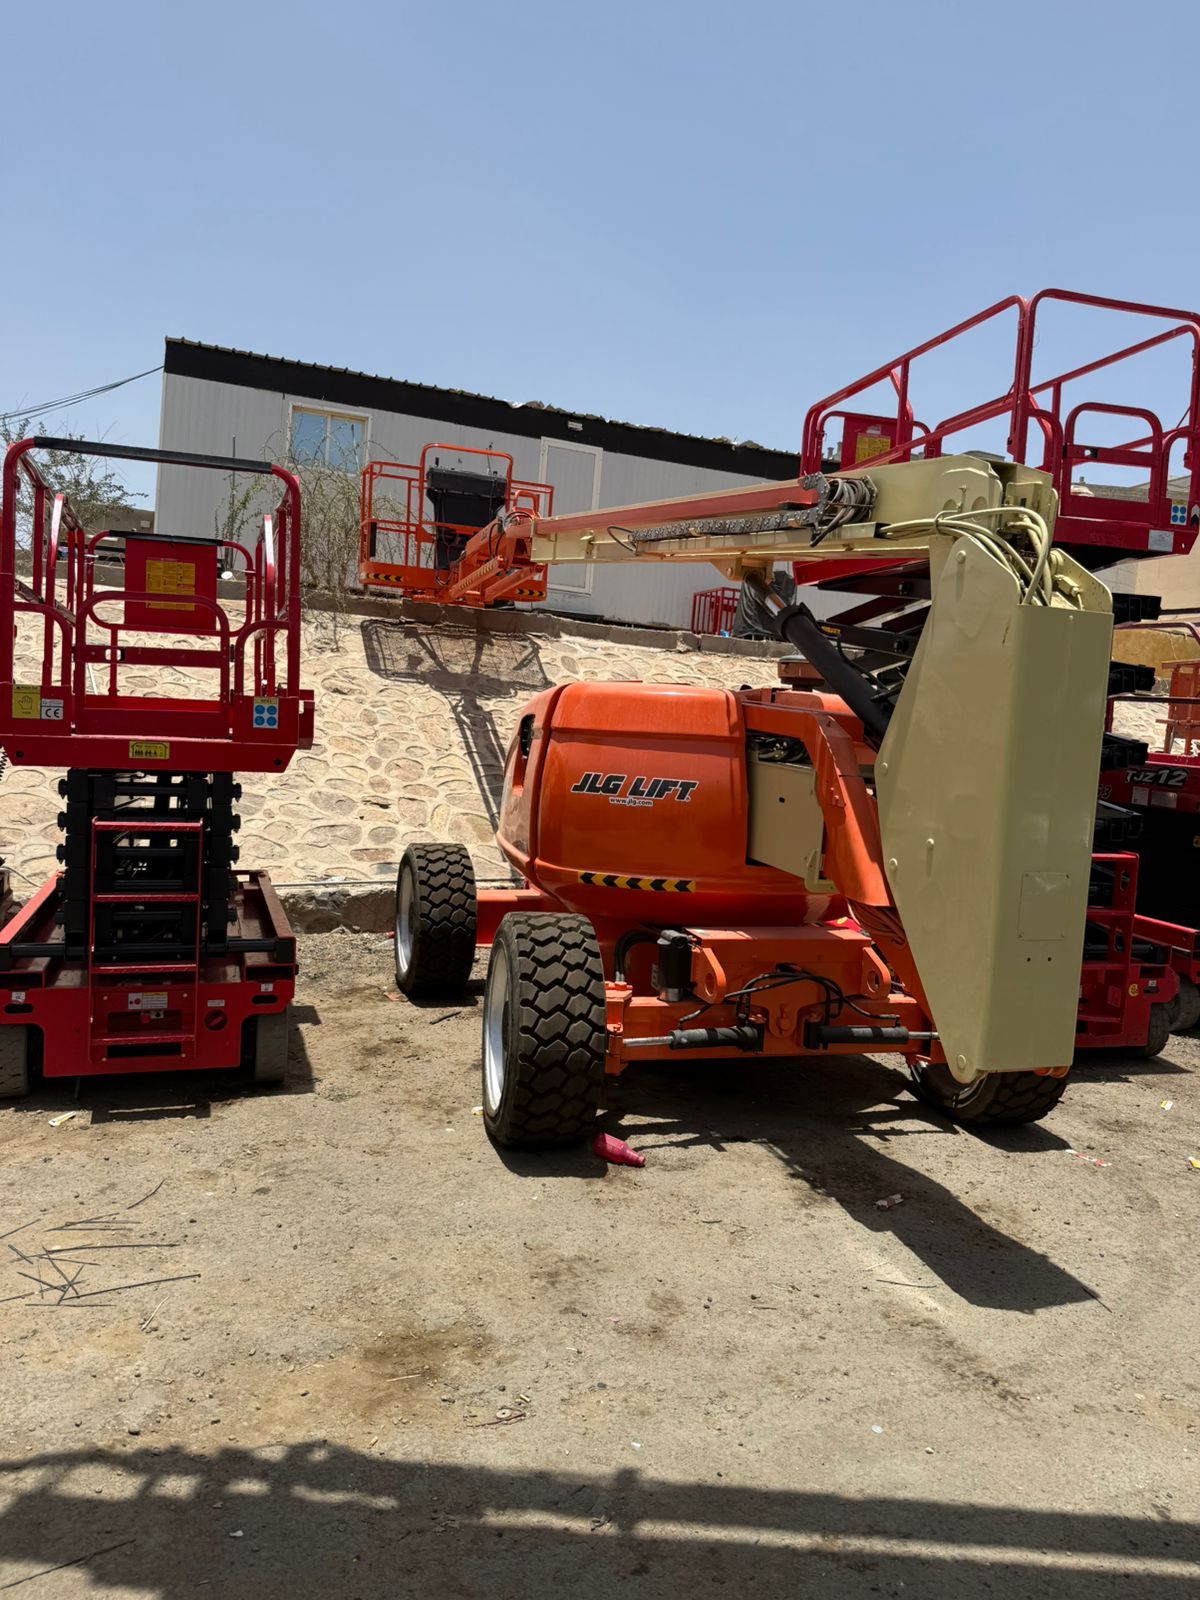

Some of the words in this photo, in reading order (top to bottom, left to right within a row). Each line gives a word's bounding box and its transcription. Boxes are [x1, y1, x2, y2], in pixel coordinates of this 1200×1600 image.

[45, 708, 60, 719] CE
[571, 772, 627, 795] JLG
[627, 776, 699, 801] LIFT
[609, 797, 653, 806] www.jlg.com
